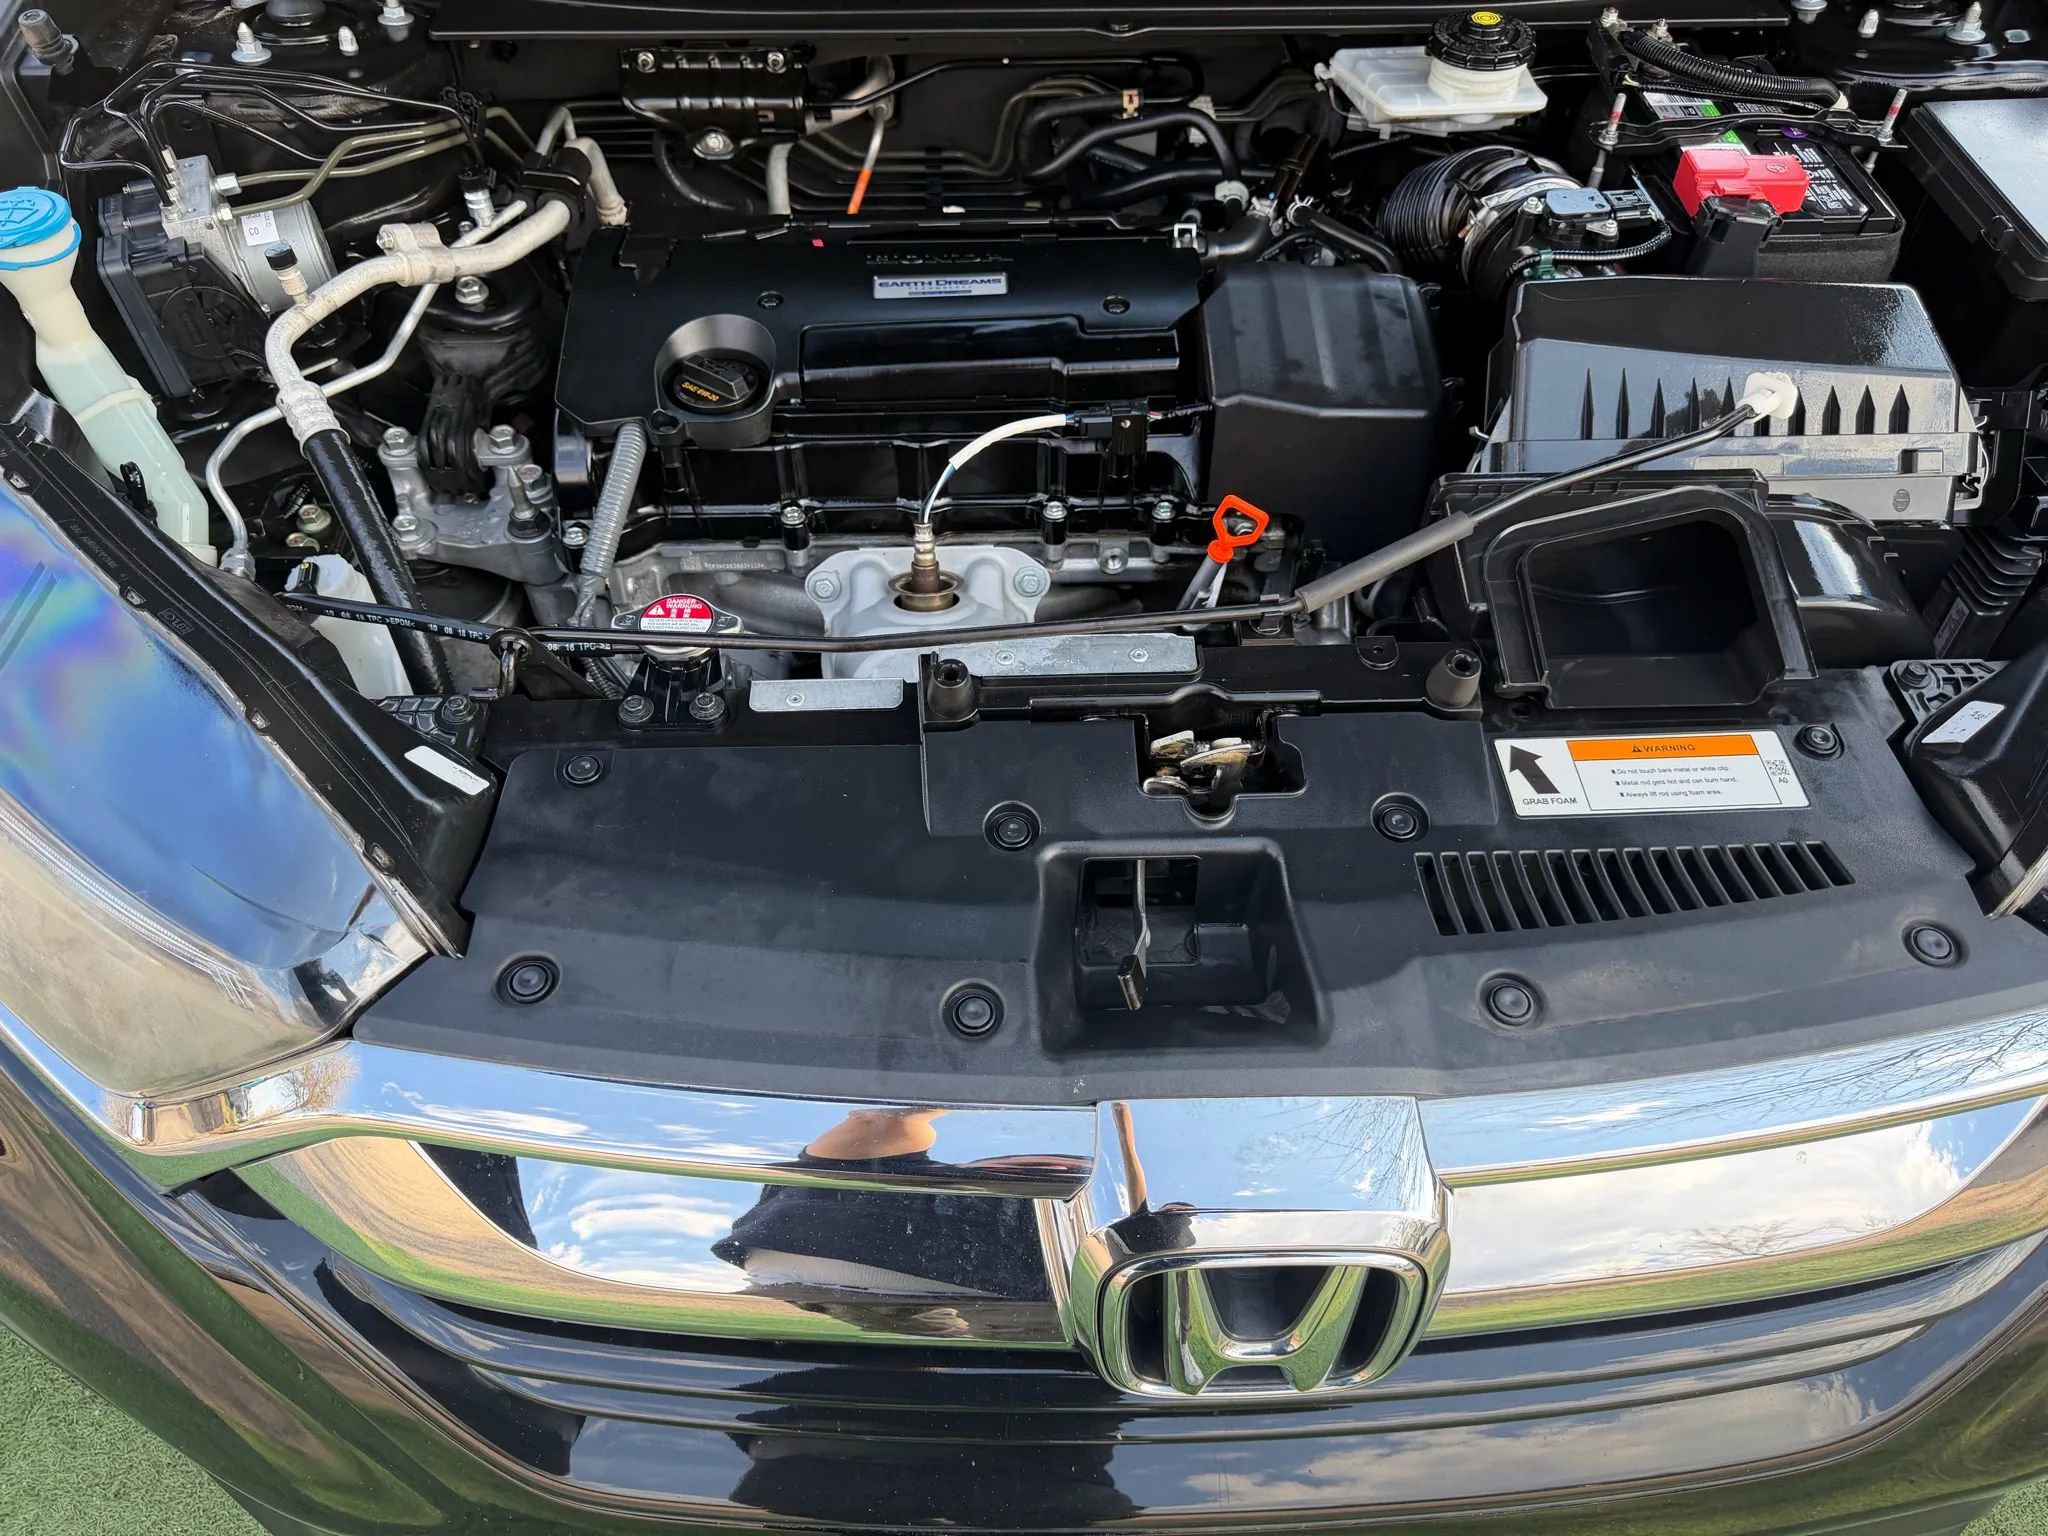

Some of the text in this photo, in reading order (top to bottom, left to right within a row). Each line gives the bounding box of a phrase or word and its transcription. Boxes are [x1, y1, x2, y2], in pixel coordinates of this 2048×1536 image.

[878, 278, 1002, 289] EARTH DREAMS
[681, 381, 700, 393] SAE
[366, 613, 383, 624] TPC
[1643, 743, 1696, 753] WARNING
[1626, 791, 1649, 799] Always
[1522, 796, 1578, 806] GRAB FOAM
